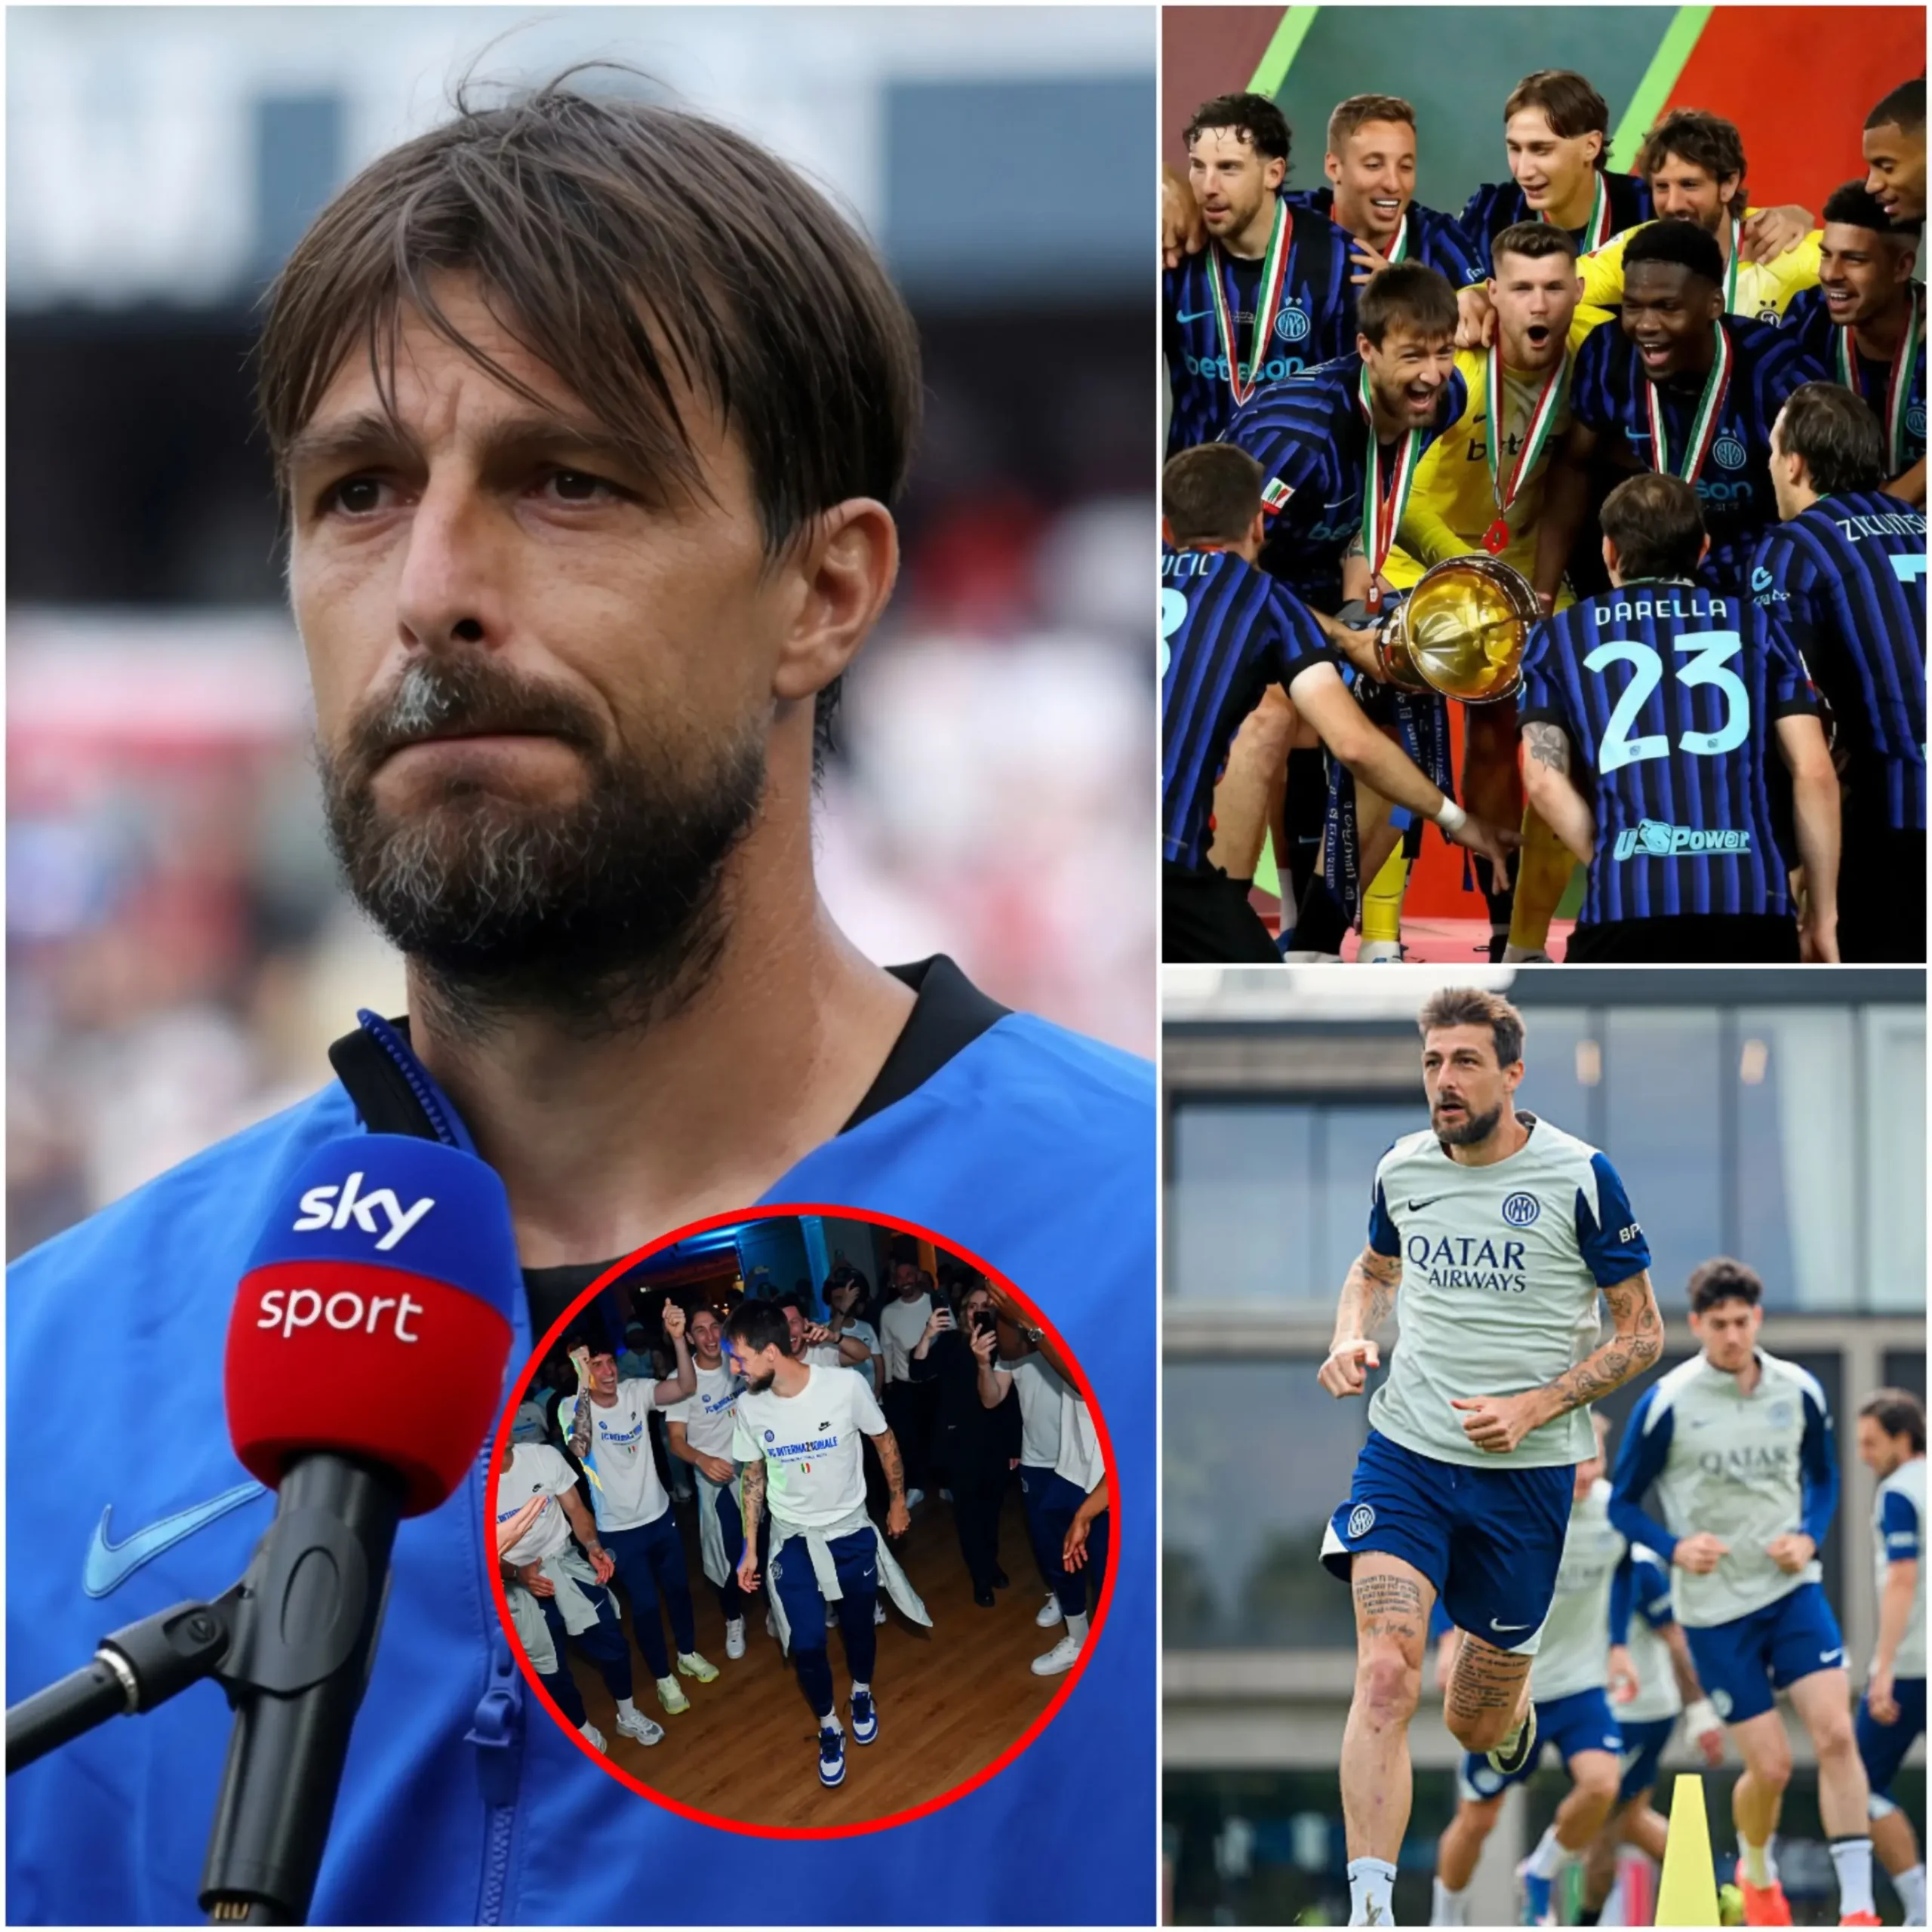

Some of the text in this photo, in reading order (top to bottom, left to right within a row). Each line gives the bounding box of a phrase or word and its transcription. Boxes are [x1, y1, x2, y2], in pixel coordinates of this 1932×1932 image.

[1583, 631, 1750, 774] 23
[293, 1171, 435, 1251] sky
[1619, 1223, 1643, 1244] BP
[1407, 1235, 1526, 1271] QATAR
[1429, 1268, 1526, 1293] AIRWAYS
[257, 1289, 423, 1343] sport
